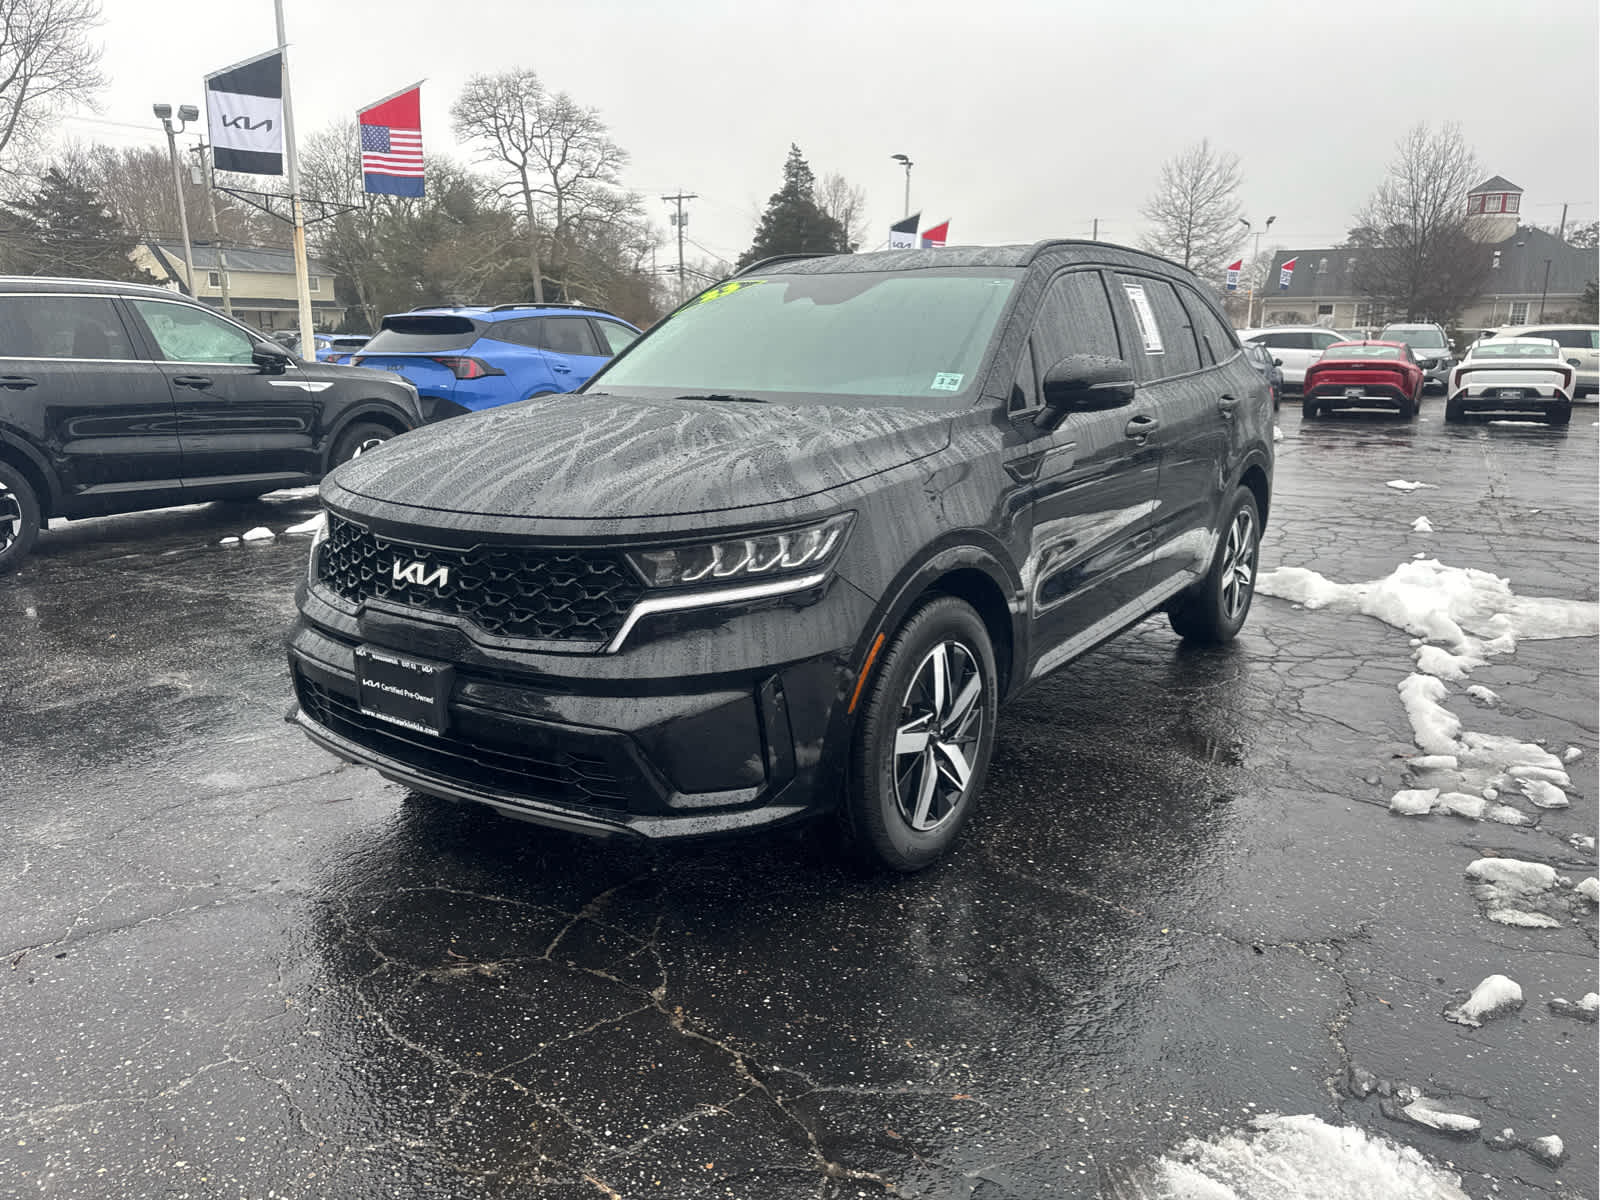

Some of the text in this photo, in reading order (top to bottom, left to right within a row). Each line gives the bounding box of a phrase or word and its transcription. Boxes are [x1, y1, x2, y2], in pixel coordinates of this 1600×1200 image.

[222, 114, 273, 132] KIA
[393, 559, 449, 588] KIA
[381, 682, 404, 696] Certified
[404, 689, 434, 705] Pre-Owned
